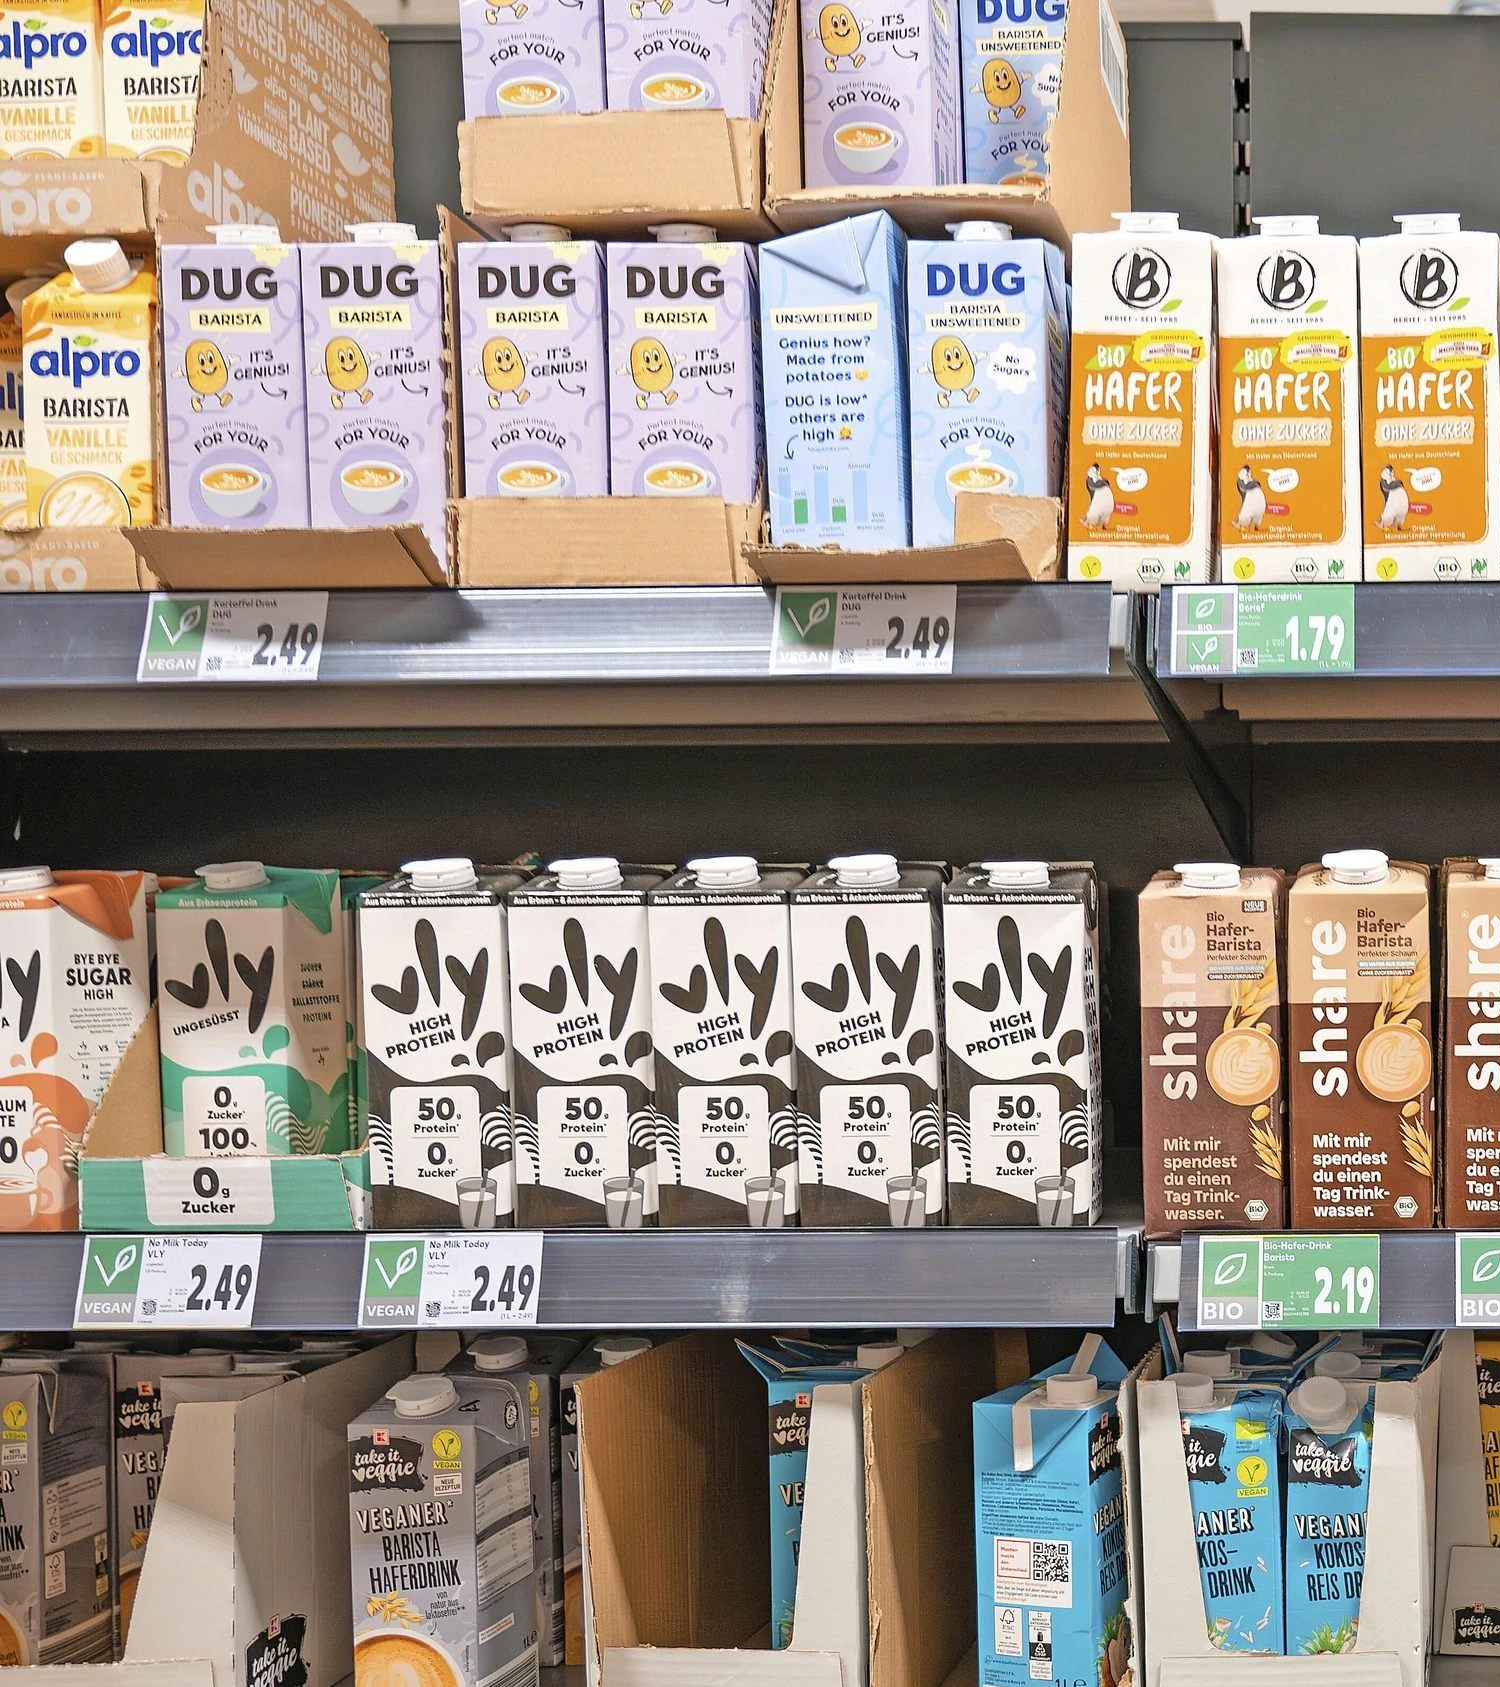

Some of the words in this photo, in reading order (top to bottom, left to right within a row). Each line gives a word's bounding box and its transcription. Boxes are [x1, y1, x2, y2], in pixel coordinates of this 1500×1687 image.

[881, 14, 905, 27] IT'S
[866, 28, 921, 43] GENIUS!
[998, 30, 1044, 39] BARISTA
[634, 41, 663, 62] FOR
[668, 39, 710, 61] YOUR
[981, 41, 1062, 52] UNSWEETENED
[1, 107, 75, 125] VANILLE
[288, 98, 330, 147] PLANT
[4, 129, 72, 142] GESCHMACK
[289, 124, 331, 175] BASED
[181, 267, 278, 301] DUG
[199, 312, 262, 327] BARISTA
[775, 311, 873, 325] UNSWEETENED
[779, 337, 830, 350] Genius
[833, 336, 871, 350] how?
[30, 337, 141, 388] alpro
[786, 354, 826, 366] Made
[831, 353, 865, 364] from
[786, 369, 852, 385] potatoes
[1085, 371, 1184, 412] HAFER
[43, 398, 130, 418] BARISTA
[790, 412, 837, 424] others
[841, 412, 866, 423] are
[47, 429, 128, 448] VANILLE
[802, 428, 835, 442] high
[1089, 422, 1124, 440] OHNE
[1128, 422, 1179, 442] ZUCKER
[883, 592, 907, 601] Drink
[212, 610, 232, 619] DUG
[252, 623, 318, 667] 2.49
[885, 616, 950, 660] 2.49
[1285, 615, 1345, 662] 1.79
[147, 658, 196, 671] VEGAN
[1357, 908, 1376, 919] Bio
[1357, 920, 1406, 934] Hafer-
[1357, 935, 1413, 948] Barista
[74, 954, 94, 965] BYE
[97, 954, 120, 965] BYE
[66, 968, 132, 986] SUGAR
[84, 988, 114, 1000] HIGH
[1149, 923, 1198, 1101] share
[173, 1010, 240, 1036] UNGESÜSST
[409, 1014, 451, 1036] HIGH
[386, 1028, 456, 1058] PROTEIN
[1312, 1134, 1341, 1149] Mit
[1344, 1133, 1372, 1149] mir
[1466, 1163, 1487, 1177] du
[182, 1201, 235, 1214] Zucker
[149, 1239, 160, 1247] No
[162, 1239, 179, 1247] Milk
[182, 1239, 208, 1248] Today
[1264, 1241, 1332, 1250] Bio-Hafer-Drink
[148, 1250, 165, 1258] VLY
[1264, 1253, 1295, 1262] Barista
[186, 1264, 252, 1311] 2.49
[471, 1265, 535, 1312] 2.49
[1314, 1266, 1374, 1314] 2.19
[84, 1302, 131, 1314] VEGAN
[367, 1305, 415, 1317] VEGAN
[1203, 1302, 1244, 1320] BIO
[354, 1449, 385, 1467] take
[352, 1459, 415, 1482] veggie
[434, 1483, 461, 1492] REZEPTUR
[1239, 1488, 1267, 1496] VEGAN
[381, 1531, 442, 1562] BARISTA
[369, 1560, 462, 1594] HAFERDRINK
